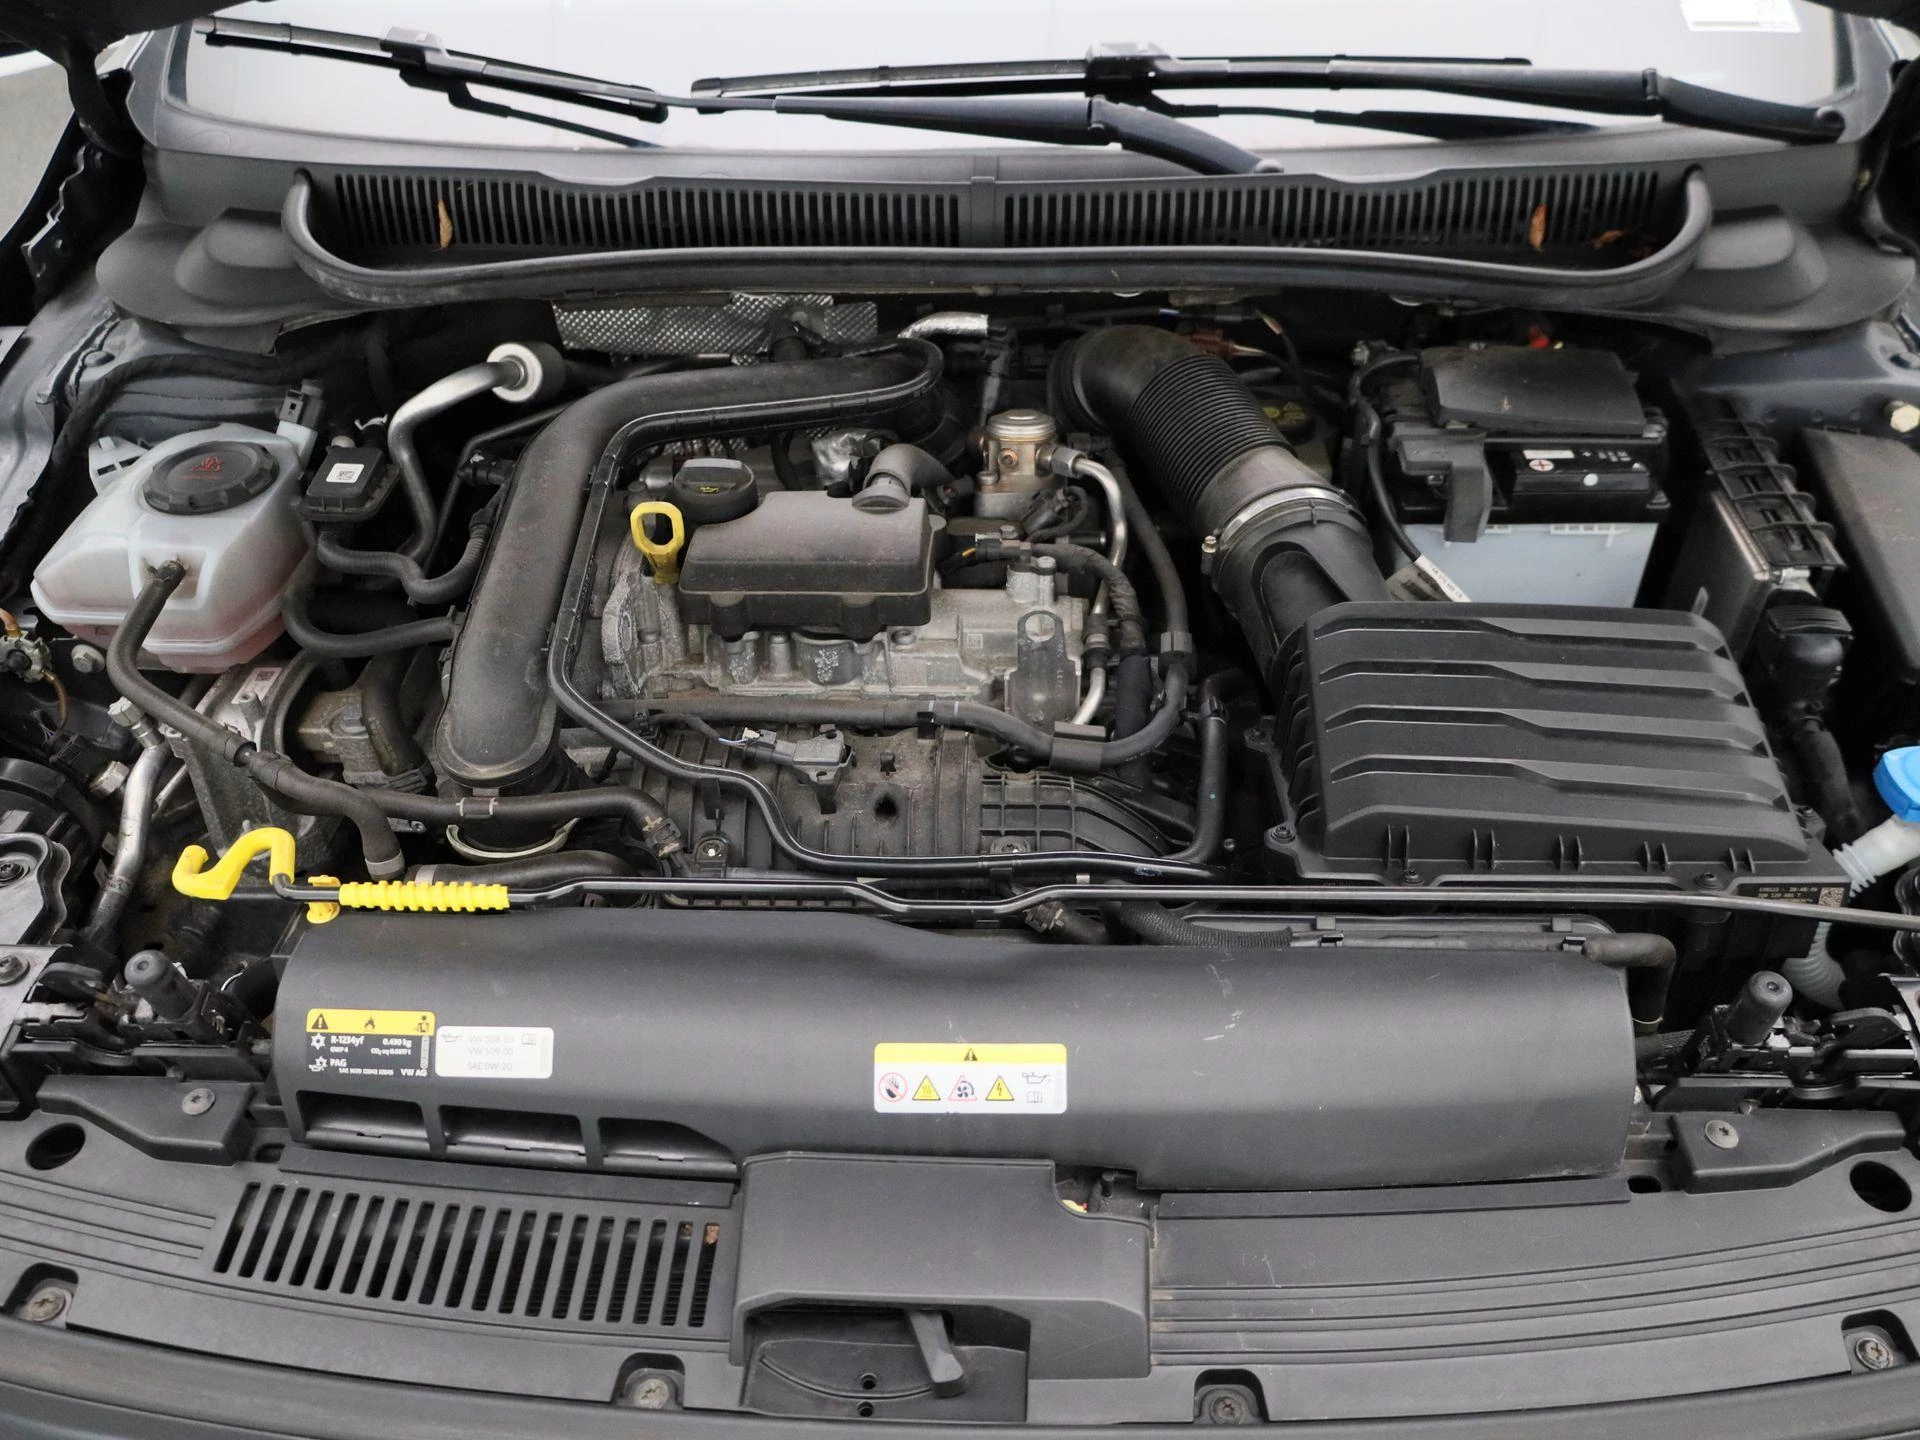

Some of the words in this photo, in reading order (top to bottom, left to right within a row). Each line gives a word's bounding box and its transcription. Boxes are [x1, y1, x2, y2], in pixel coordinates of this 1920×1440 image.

[402, 1038, 412, 1048] kg
[468, 1047, 482, 1056] VW
[330, 1058, 347, 1067] PAG
[466, 1062, 481, 1071] SAE
[400, 1068, 415, 1076] VW
[415, 1068, 428, 1077] AG
